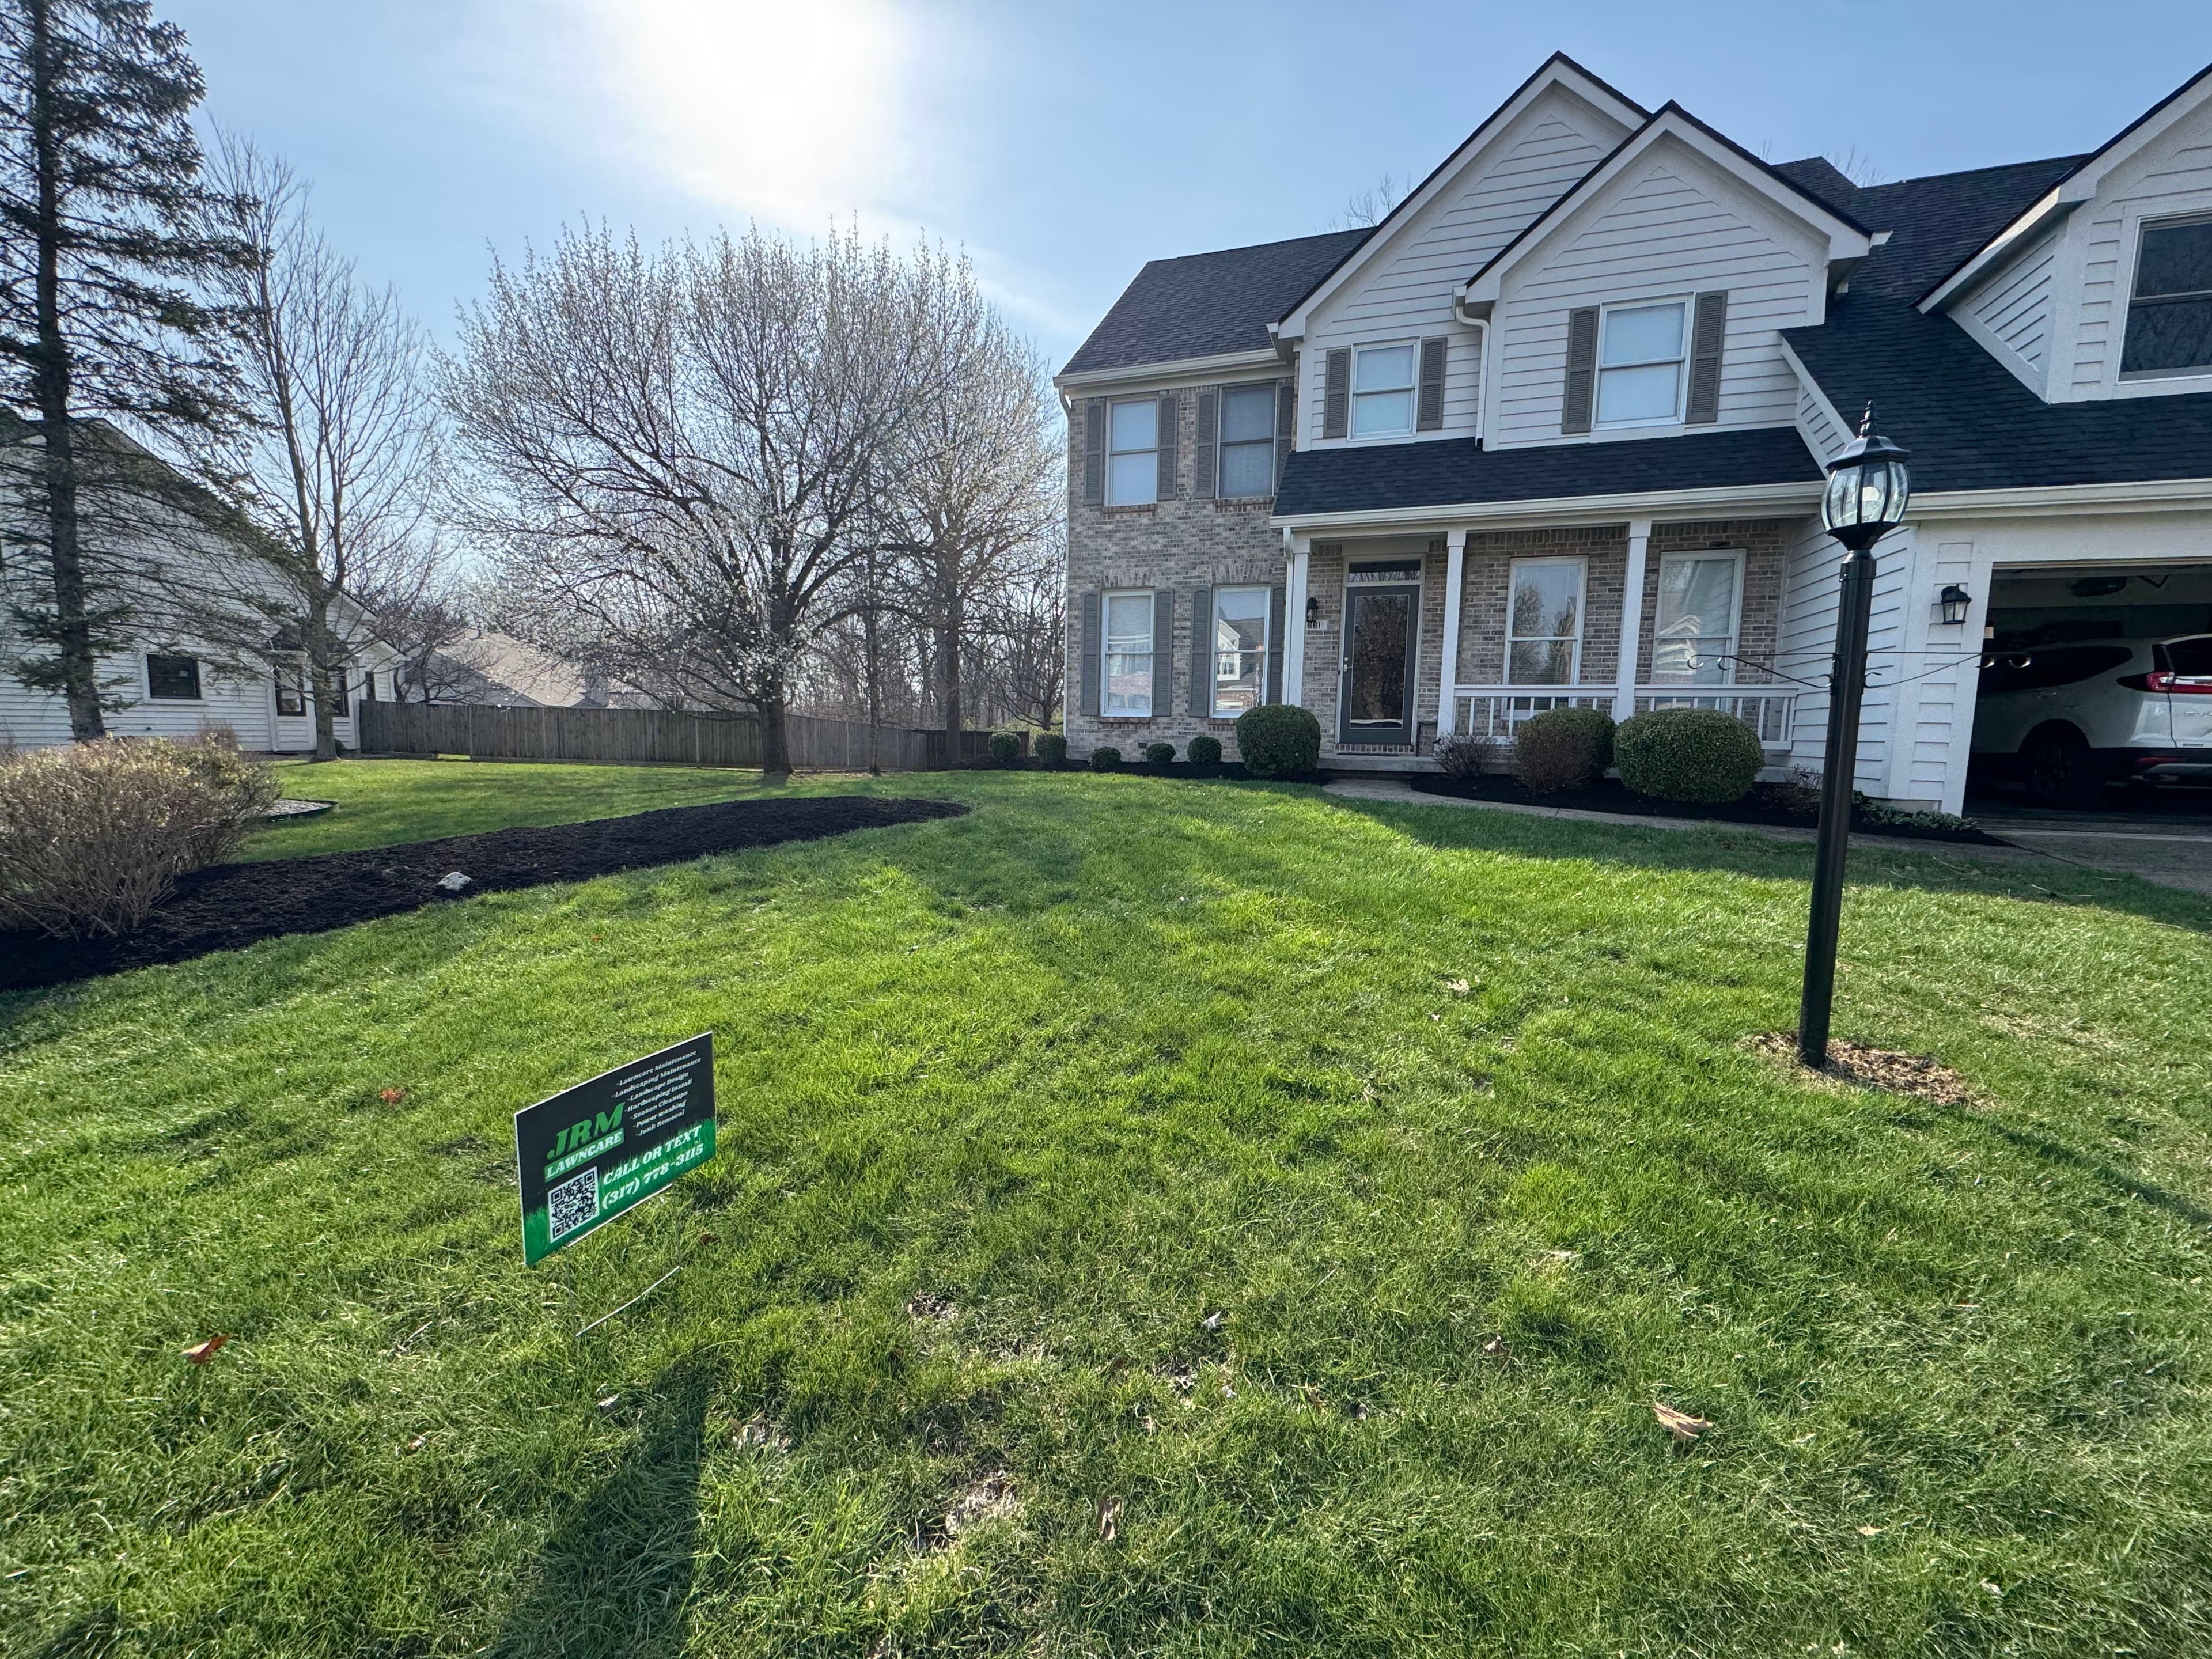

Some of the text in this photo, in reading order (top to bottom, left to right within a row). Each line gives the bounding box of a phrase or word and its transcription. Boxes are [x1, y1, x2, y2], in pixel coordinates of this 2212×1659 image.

[654, 1051, 696, 1071] Maintenance
[660, 1058, 701, 1078] Maintenance
[666, 1072, 689, 1085] Design
[671, 1078, 692, 1092] Install
[658, 1090, 688, 1107] Cleanups
[658, 1099, 687, 1117] washing
[657, 1109, 684, 1127] Removal
[547, 1101, 626, 1160] JRM
[547, 1131, 623, 1179] LAWNCARE
[603, 1125, 702, 1185] CALL OR TEXT
[602, 1143, 704, 1210] (317) 778-3115
